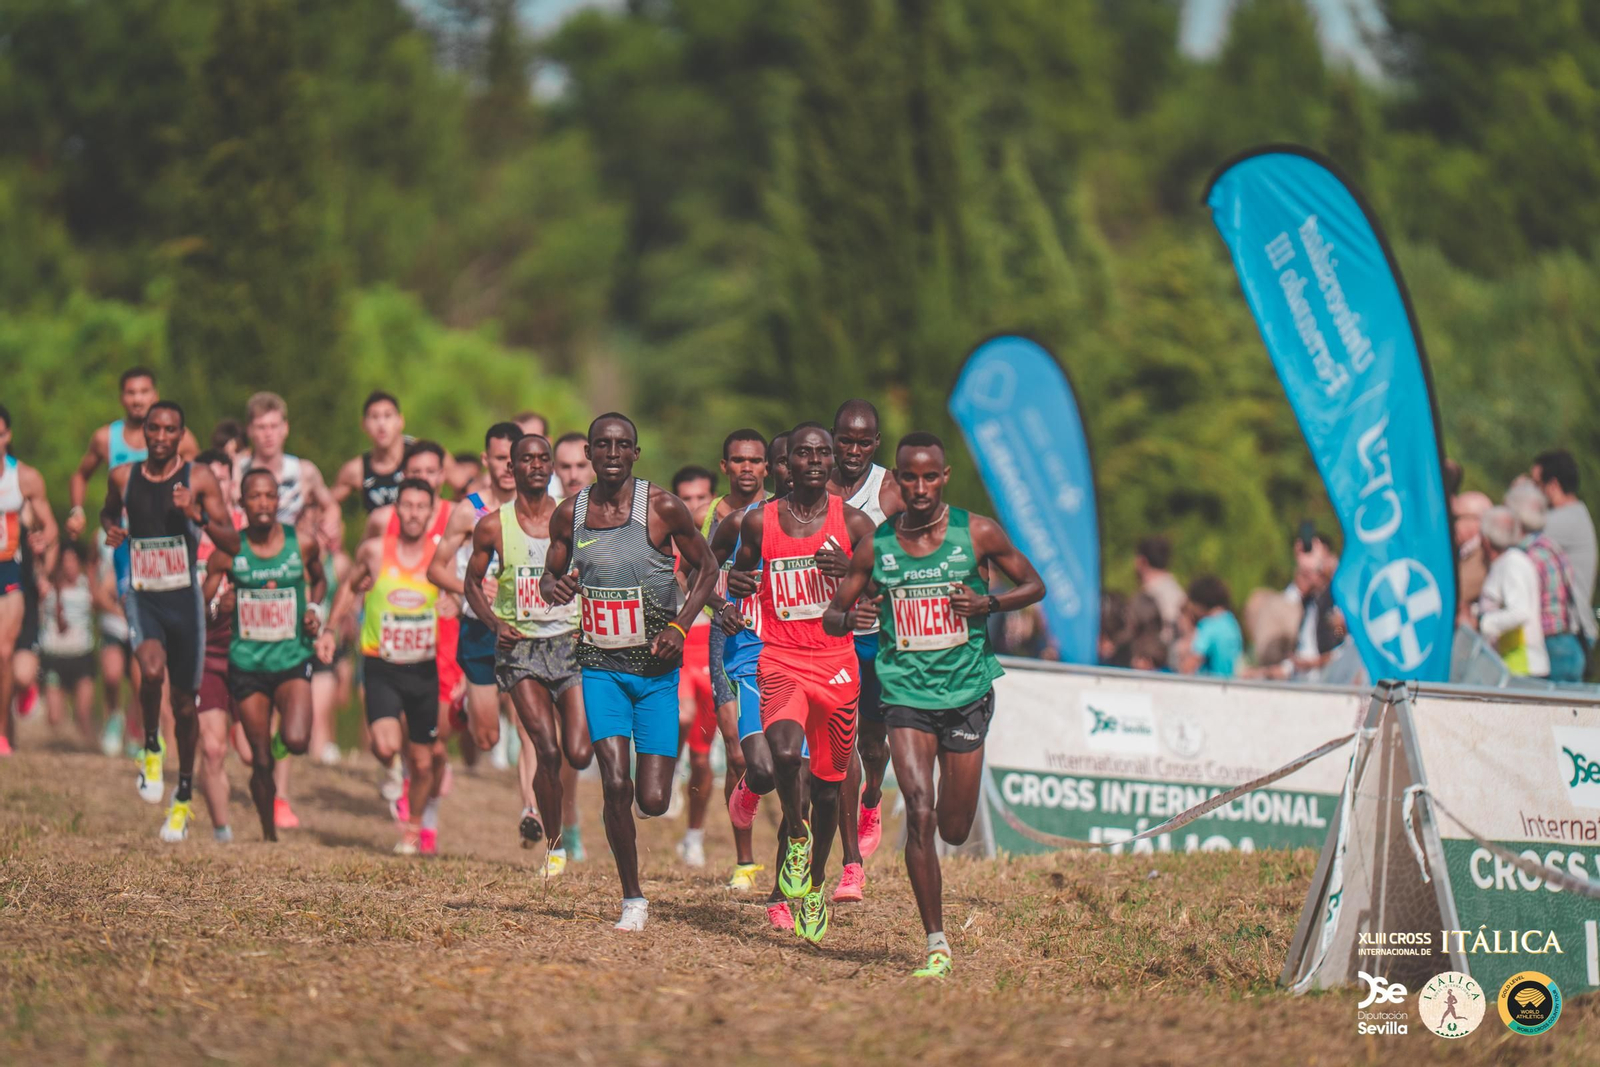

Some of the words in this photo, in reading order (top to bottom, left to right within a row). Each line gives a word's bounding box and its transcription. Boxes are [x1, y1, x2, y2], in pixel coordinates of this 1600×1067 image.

[787, 557, 817, 569] ITÁLIC
[581, 597, 640, 636] BETT
[894, 597, 965, 637] KWIZERA
[1044, 749, 1152, 776] International
[1154, 757, 1202, 779] Cross
[1002, 772, 1097, 812] CROSS
[1100, 780, 1327, 829] INTERNACIONAL
[1519, 809, 1600, 842] Interna
[1469, 847, 1590, 893] CROSS
